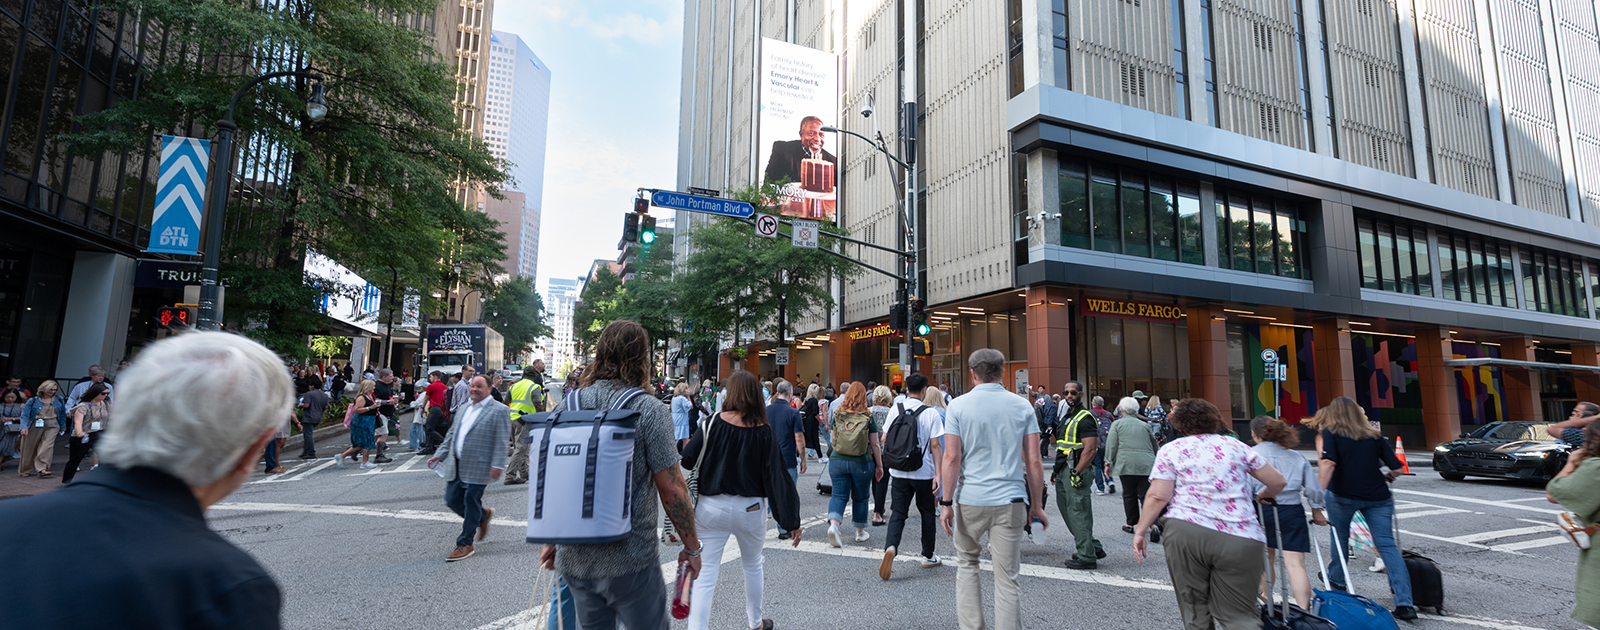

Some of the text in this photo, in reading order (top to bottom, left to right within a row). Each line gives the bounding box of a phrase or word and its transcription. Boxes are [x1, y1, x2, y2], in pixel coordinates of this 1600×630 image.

[771, 54, 814, 70] Family history
[779, 64, 797, 73] heart
[771, 70, 793, 81] Emory
[794, 75, 813, 85] Heart
[771, 78, 800, 90] Vascular
[770, 87, 785, 96] help
[787, 91, 808, 101] rewrite
[665, 194, 685, 206] John
[687, 197, 721, 211] Portman
[724, 202, 740, 214] Blvd
[160, 226, 189, 237] ATL
[160, 235, 189, 247] DTN
[1086, 298, 1182, 319] WELLS FARGO
[440, 334, 471, 345] ELYSIAN
[851, 328, 873, 340] WELLS
[777, 355, 788, 363] 25
[556, 445, 579, 455] YETI
